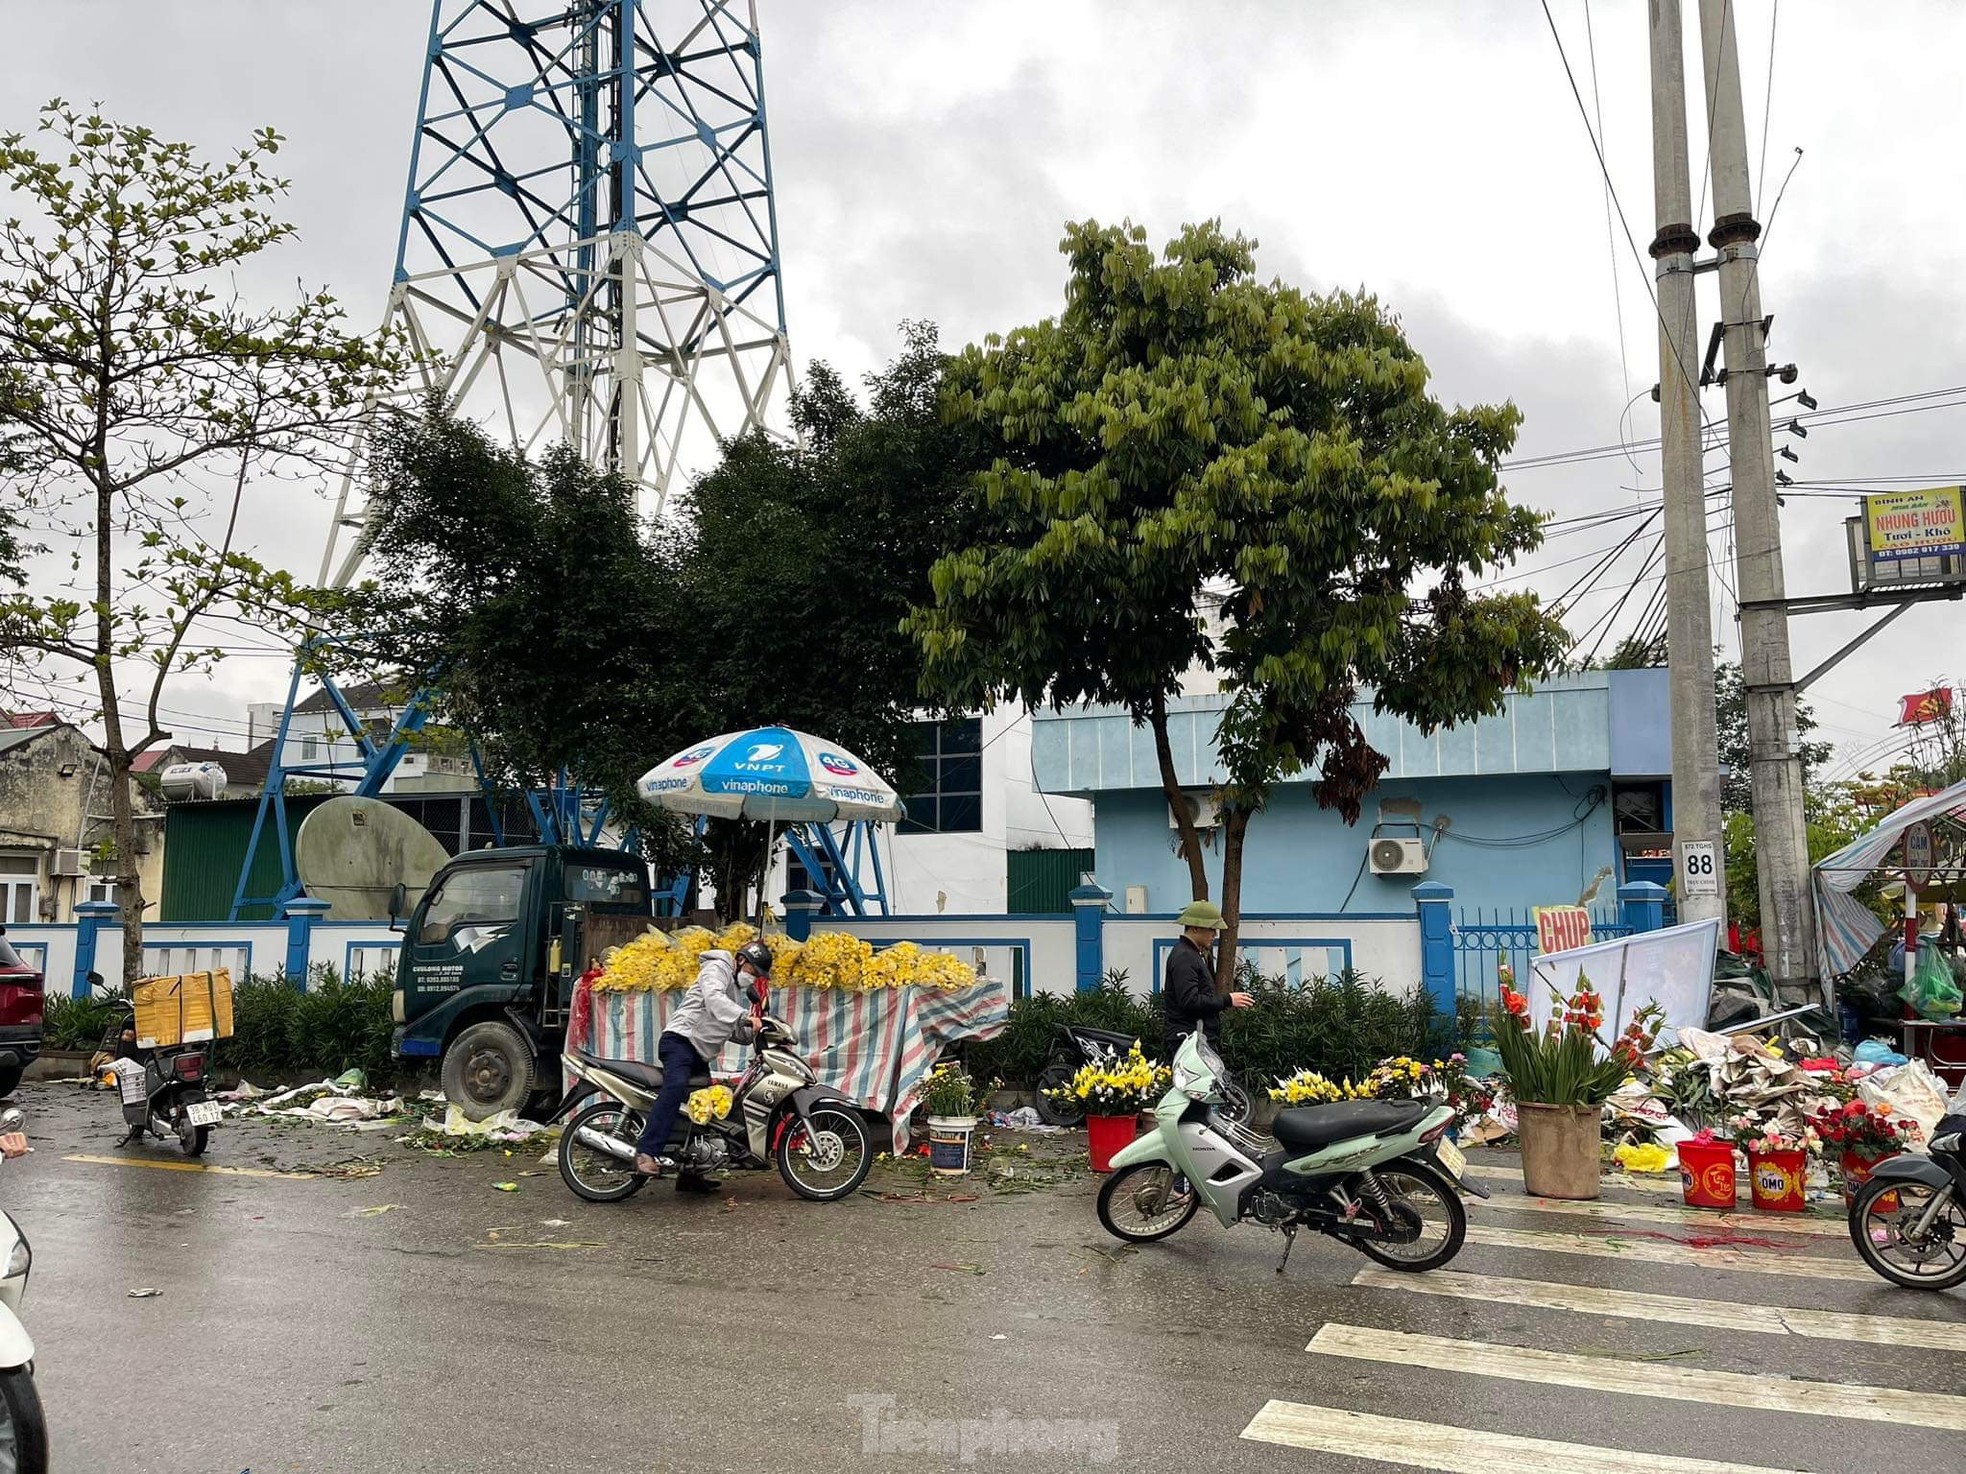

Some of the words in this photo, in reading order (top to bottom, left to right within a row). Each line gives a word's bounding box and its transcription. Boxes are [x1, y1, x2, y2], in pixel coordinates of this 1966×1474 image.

[1876, 512, 1919, 531] NHUNG
[734, 761, 785, 773] VNPT
[646, 776, 688, 792] vinaphone
[722, 778, 788, 794] vinaphone
[828, 784, 885, 804] vinaphone
[1688, 855, 1712, 875] 88
[1761, 1178, 1784, 1190] OMO
